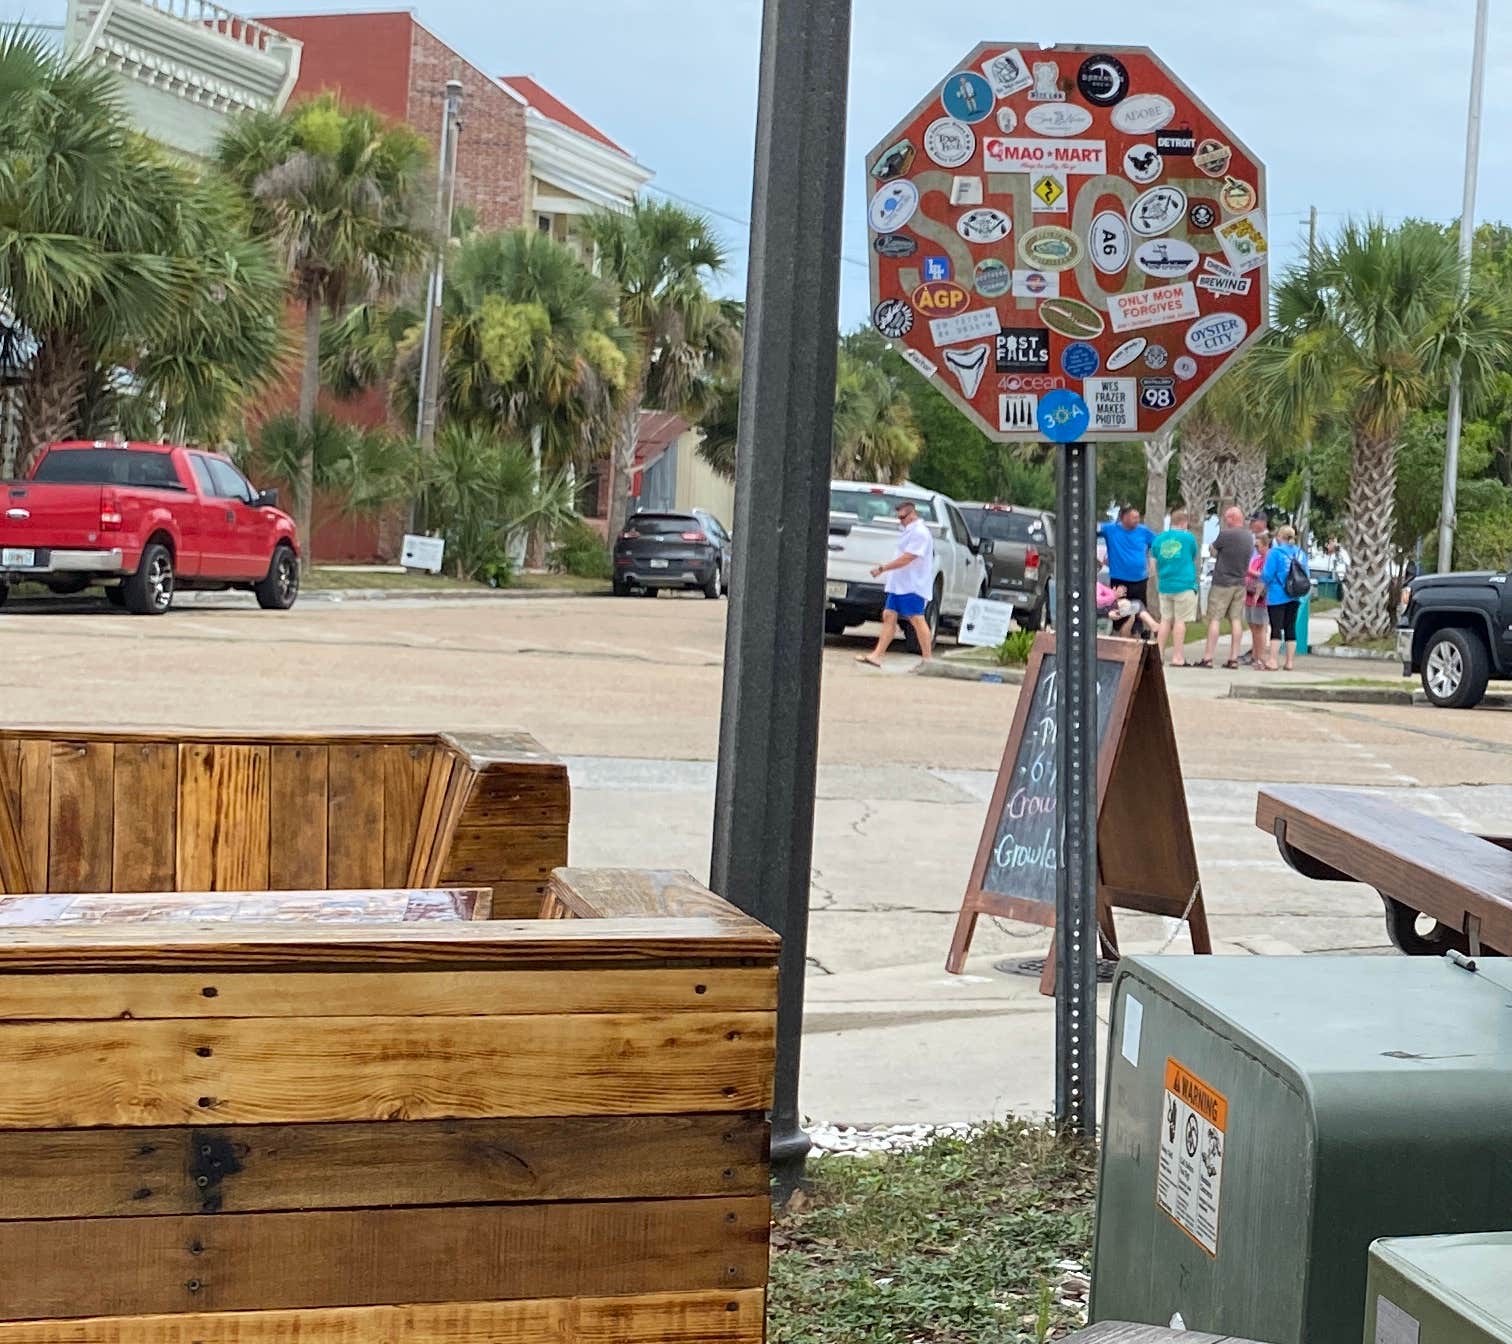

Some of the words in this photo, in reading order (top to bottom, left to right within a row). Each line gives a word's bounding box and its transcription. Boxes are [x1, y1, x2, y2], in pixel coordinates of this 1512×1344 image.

[1157, 137, 1196, 148] DETROIT
[1004, 146, 1044, 161] MAO
[1054, 147, 1103, 162] MART
[1101, 229, 1117, 256] A6
[1199, 276, 1248, 292] BREWING
[918, 288, 964, 309] AGP
[1118, 294, 1149, 308] ONLY
[1152, 287, 1184, 301] MOM
[1123, 299, 1183, 318] FORGIVES
[1190, 318, 1239, 342] OYSTER
[1204, 332, 1233, 349] CITY
[1101, 381, 1119, 391] WES
[1095, 392, 1126, 402] FRAZER
[1145, 389, 1170, 406] 98
[1096, 403, 1125, 414] MAKES
[1095, 414, 1127, 425] PHOTOS
[996, 828, 1057, 870] Growle
[1182, 1075, 1218, 1123] WARNING
